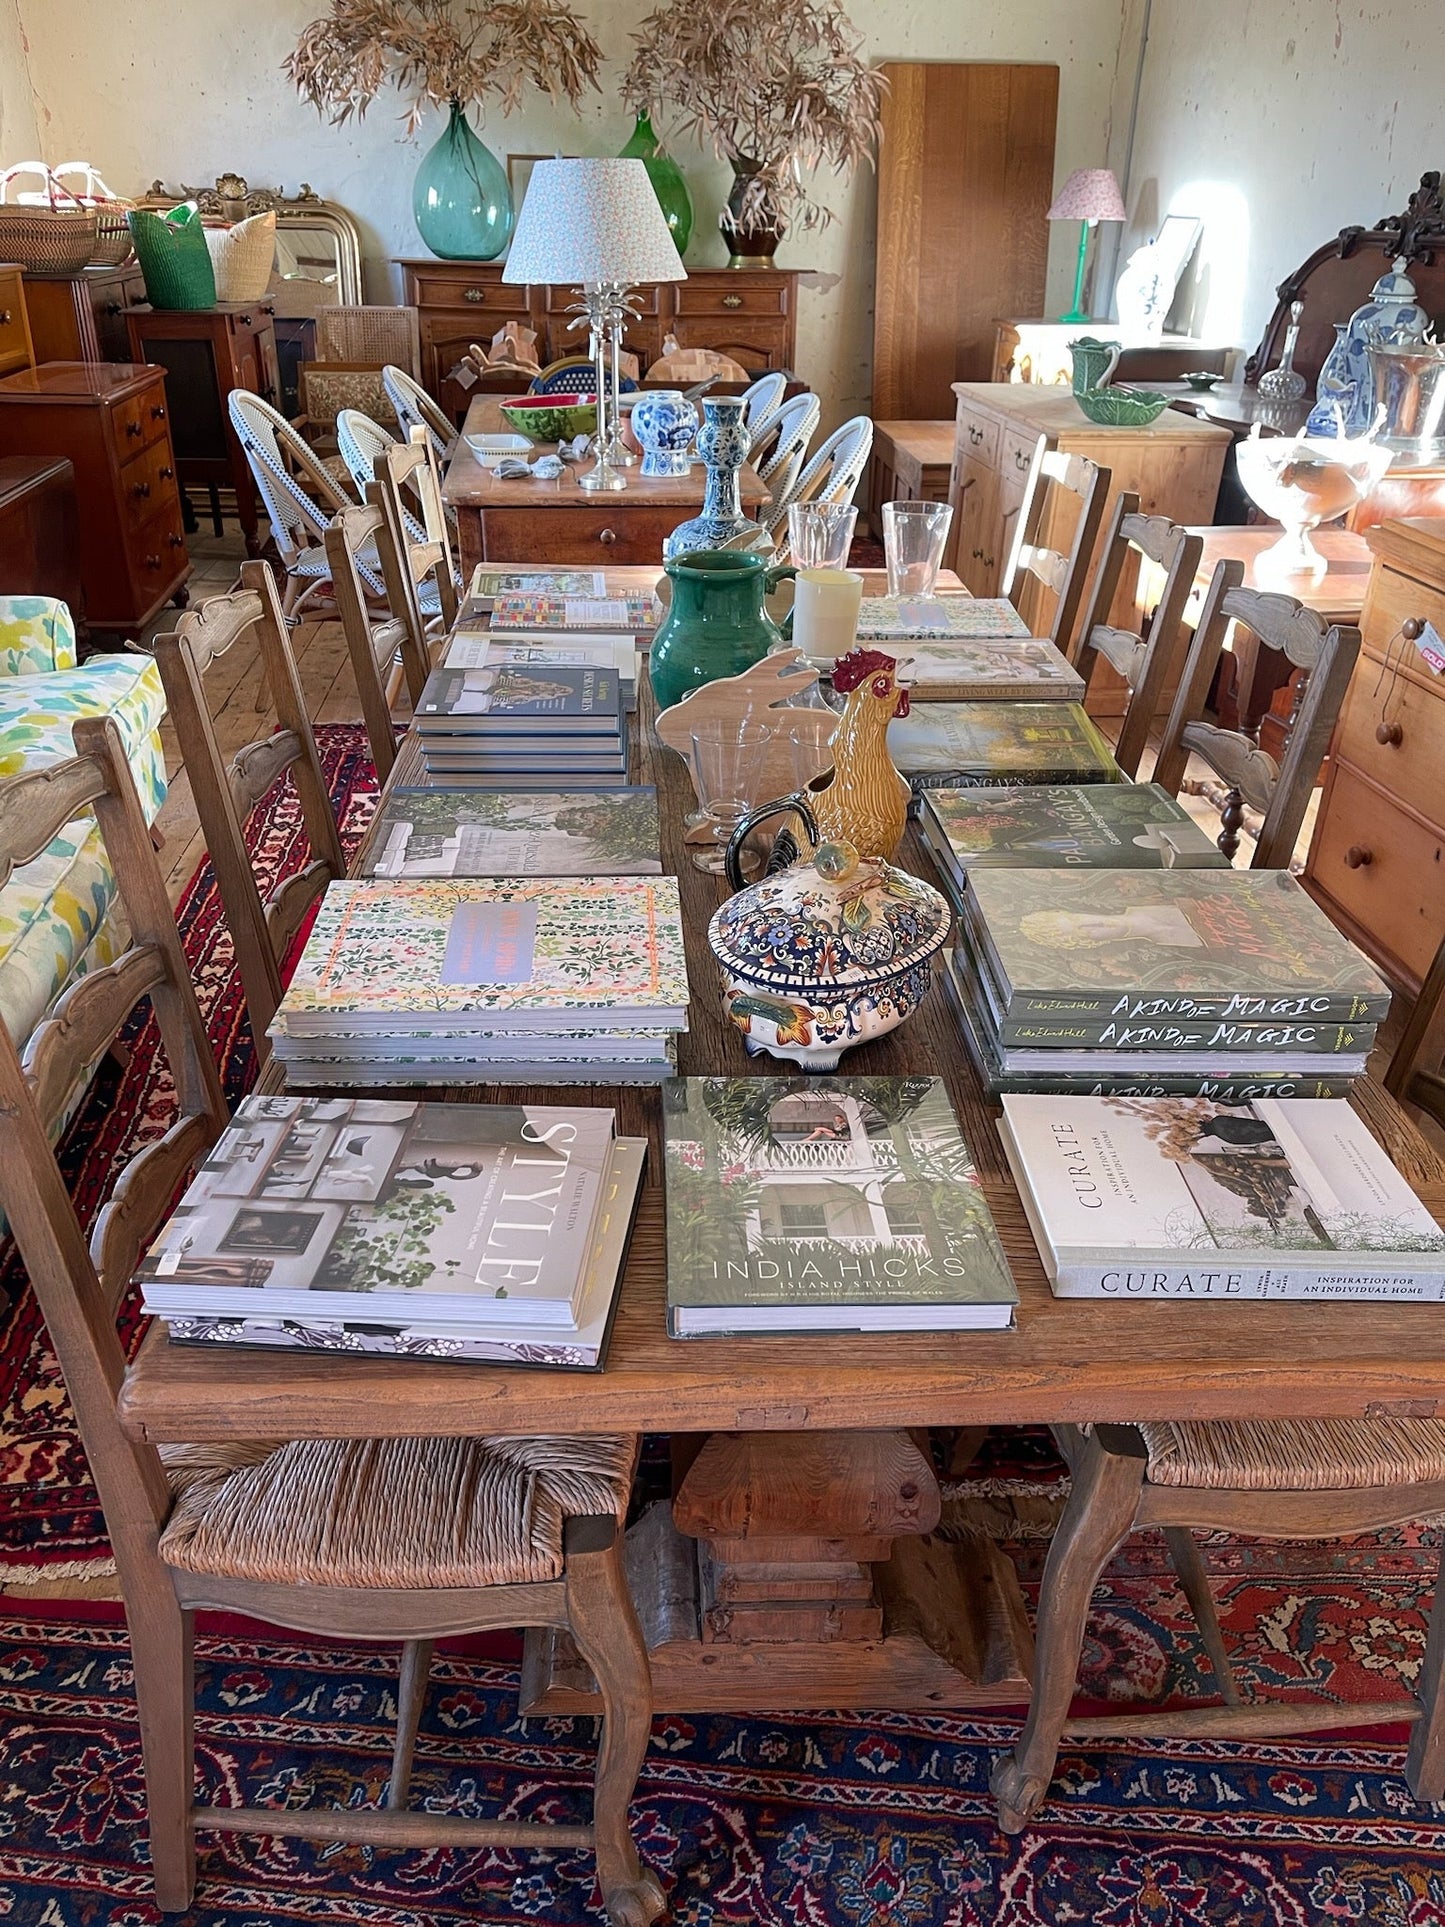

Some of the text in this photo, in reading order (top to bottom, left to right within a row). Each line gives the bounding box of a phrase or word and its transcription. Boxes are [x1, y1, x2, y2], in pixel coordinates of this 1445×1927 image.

[1422, 649, 1444, 669] SOLD
[958, 687, 985, 695] LIVING
[987, 687, 1011, 695] WELL
[909, 777, 1025, 788] PAUL BANGAY'S
[1048, 788, 1106, 846] BANGAY'S
[1071, 789, 1121, 845] Garden Design Handbook
[1049, 831, 1092, 864] PAUL
[1208, 894, 1281, 960] MAGIC
[1222, 994, 1330, 1017] MAGIC
[1208, 1024, 1317, 1046] MAGIC
[1200, 1082, 1296, 1098] MAGIC
[497, 1147, 508, 1157] THE
[1051, 1124, 1103, 1208] CURATE
[1092, 1137, 1123, 1196] INSPIRATION FOR
[1100, 1129, 1139, 1205] AN INDIVIDUAL HOME
[474, 1120, 578, 1287] STYLE
[566, 1171, 588, 1232] NATALIE WALTON
[713, 1257, 966, 1280] INDIA HICKS
[780, 1280, 906, 1289] ISLAND STYLE
[1101, 1273, 1243, 1293] CURATE
[1317, 1276, 1414, 1285] INSPIRATION FOR
[1321, 1286, 1389, 1294] INDIVIDUAL
[1391, 1287, 1424, 1295] HOME
